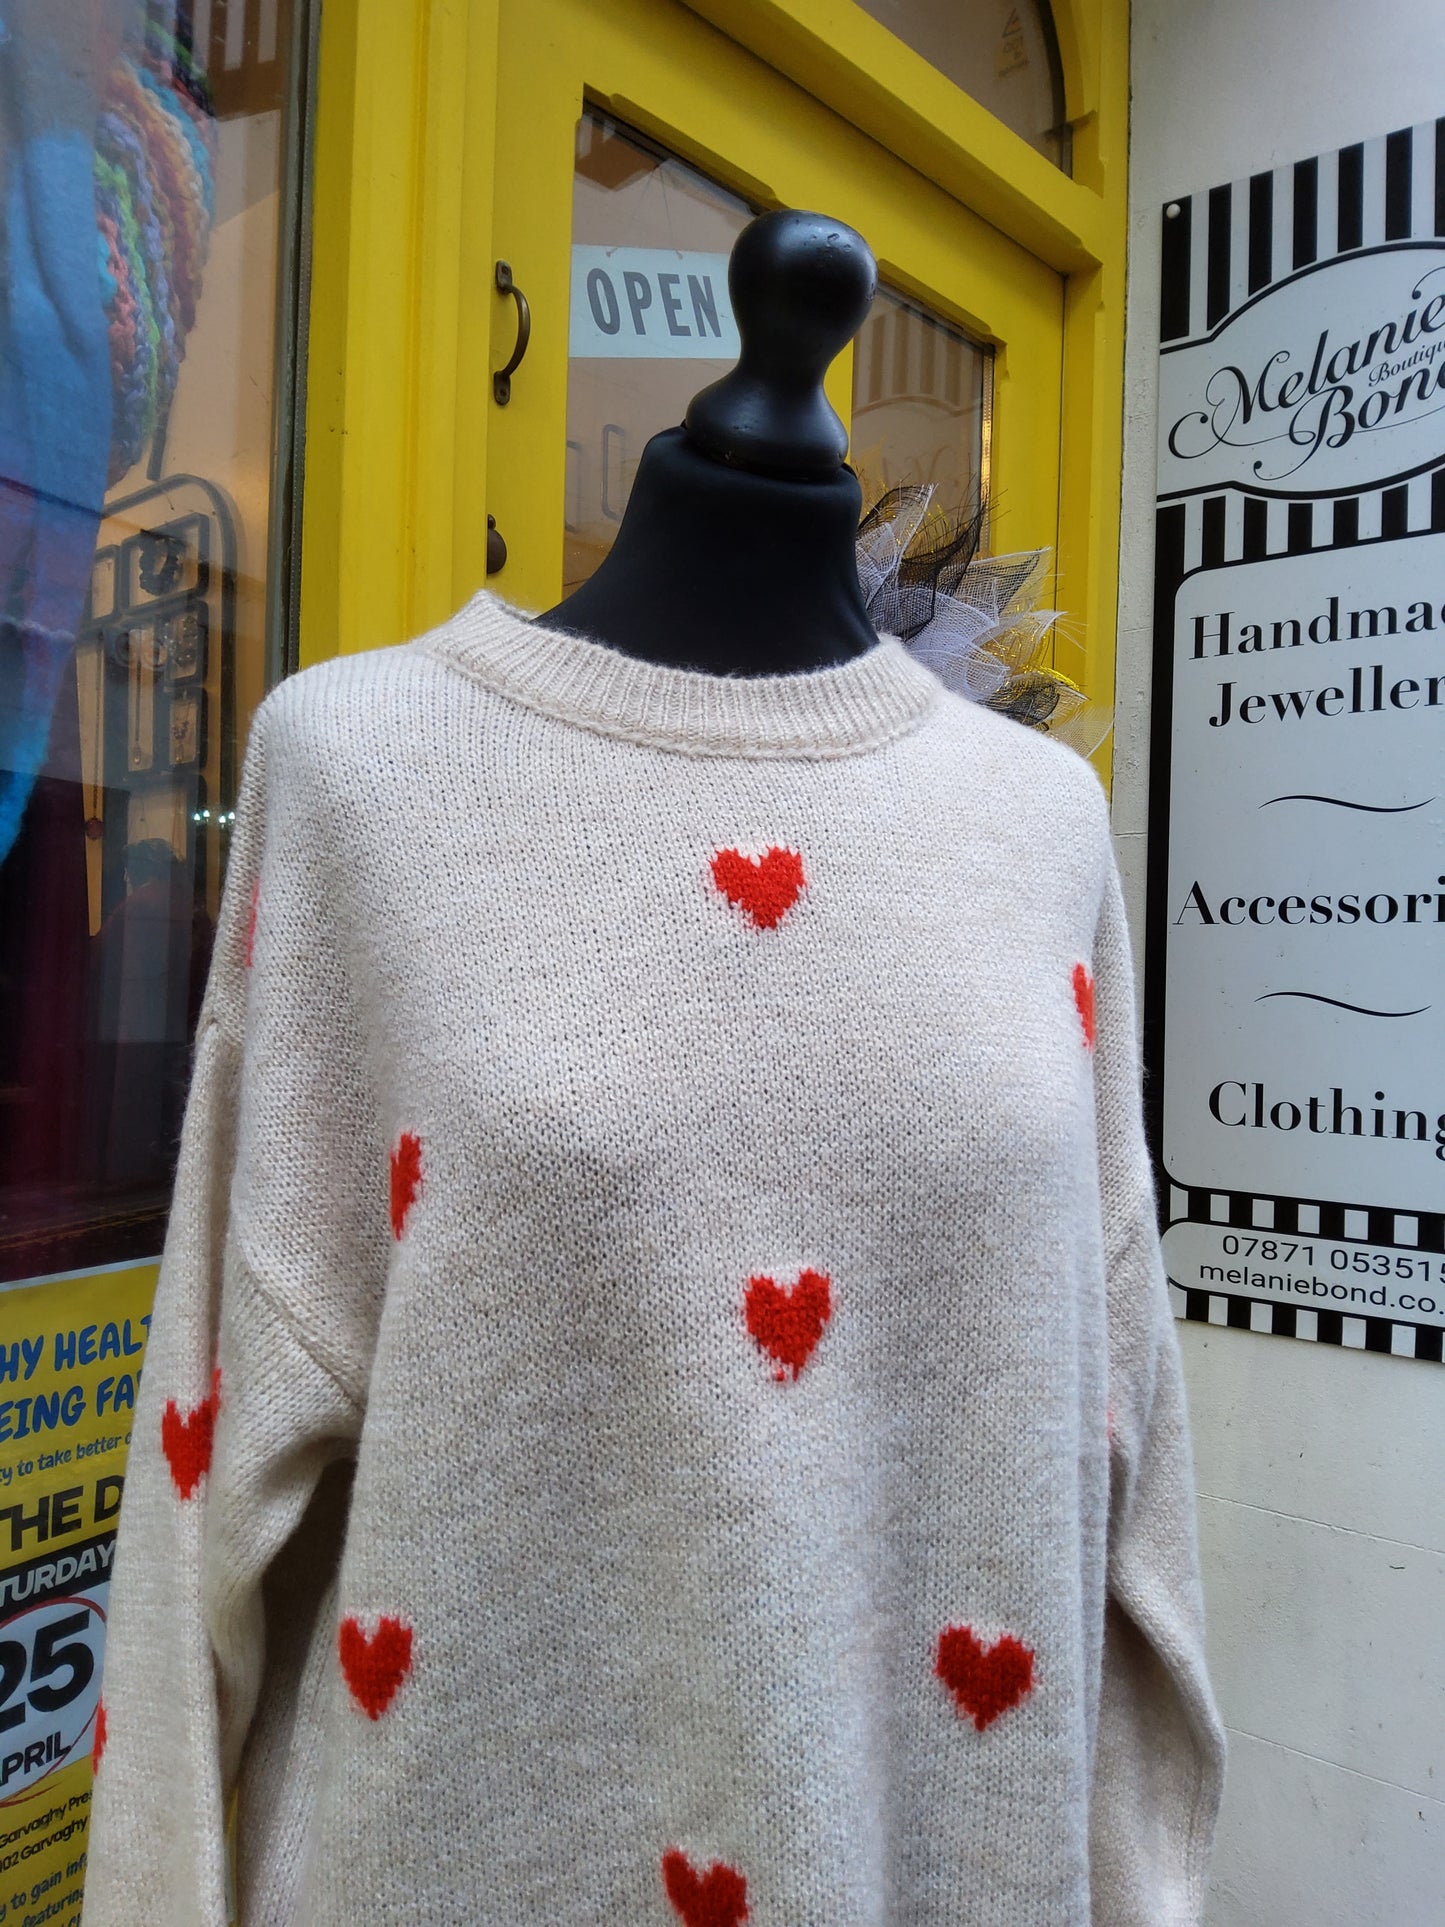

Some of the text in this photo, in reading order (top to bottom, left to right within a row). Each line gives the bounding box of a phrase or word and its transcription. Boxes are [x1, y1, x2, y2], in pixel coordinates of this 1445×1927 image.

[587, 268, 721, 337] OPEN
[1189, 597, 1445, 660] Handma
[1172, 875, 1445, 925] Accessori
[1222, 1235, 1314, 1266] 07871
[1199, 1265, 1444, 1315] melaniebond.co.
[96, 1368, 142, 1417] FA
[17, 1460, 33, 1477] to
[37, 1450, 72, 1471] take
[76, 1437, 122, 1460] better
[21, 1816, 88, 1859] Garvaghy
[31, 1871, 62, 1905] gain
